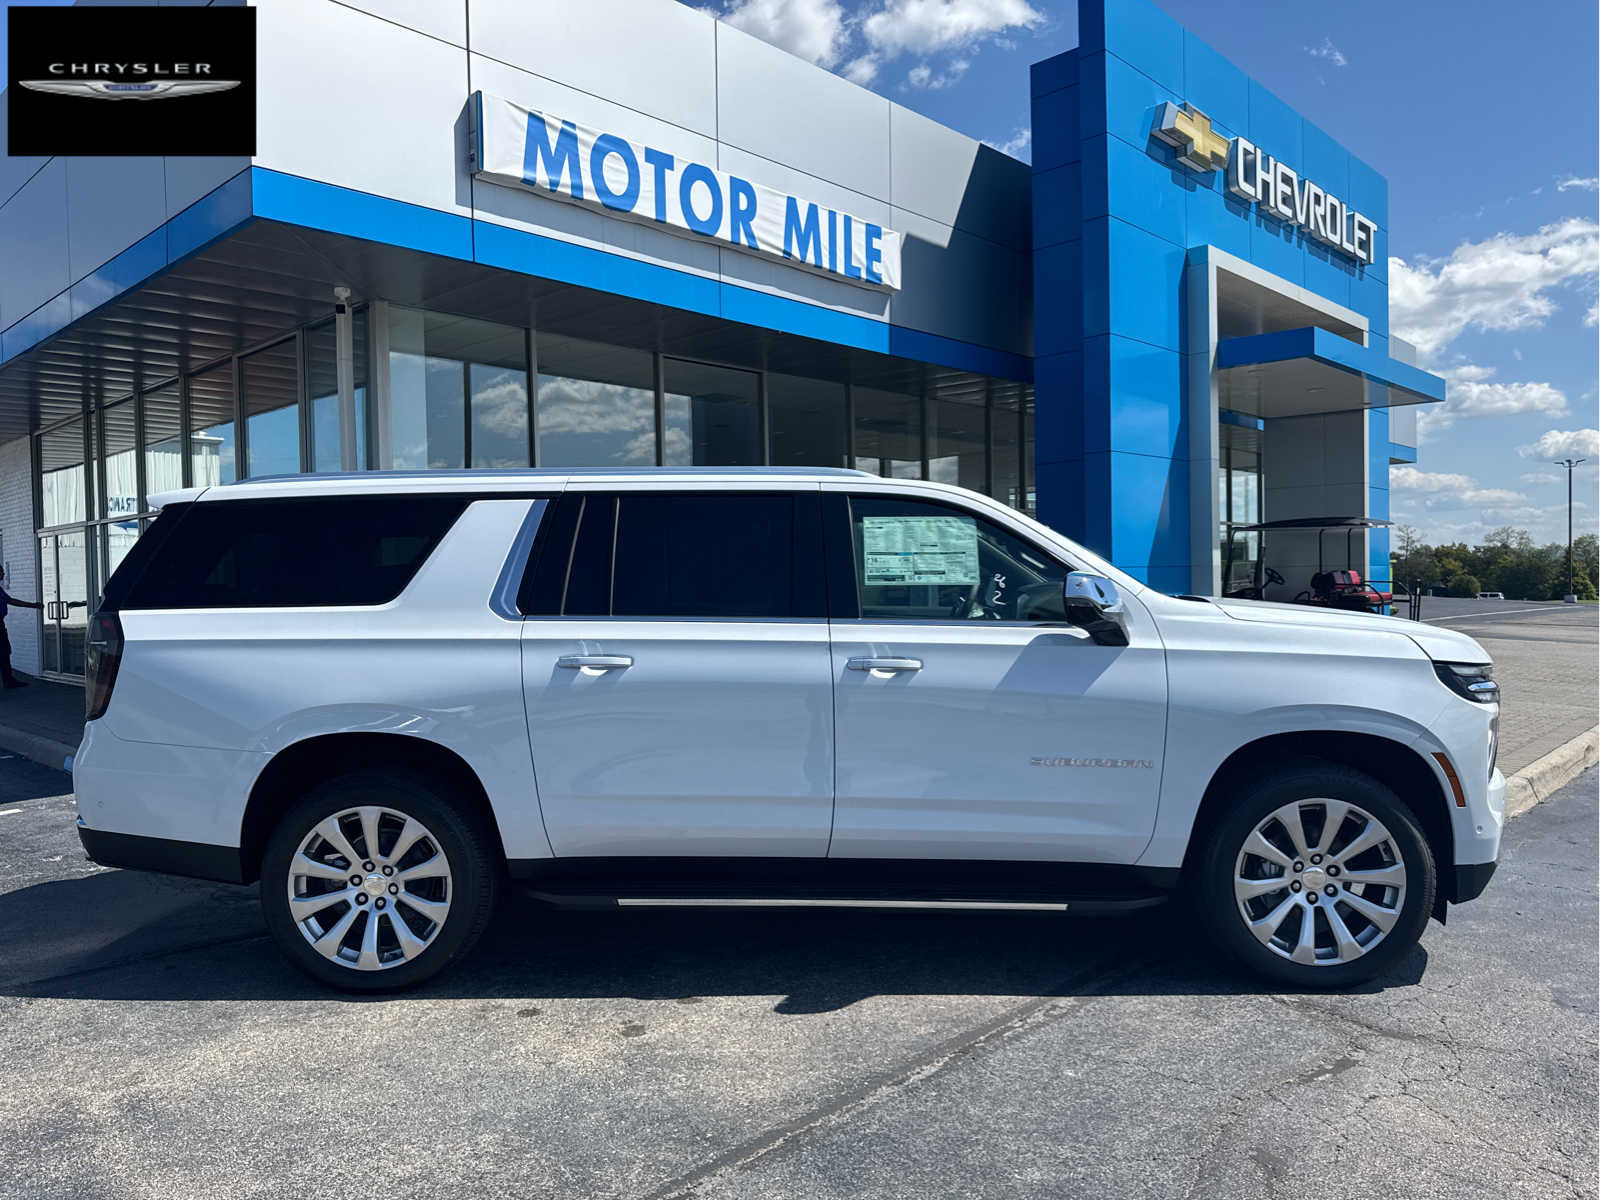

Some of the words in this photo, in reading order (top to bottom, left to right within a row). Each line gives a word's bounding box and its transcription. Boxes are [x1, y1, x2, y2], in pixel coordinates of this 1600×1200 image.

[521, 110, 760, 251] MOTOR
[782, 196, 883, 285] MILE
[1236, 136, 1378, 264] CHEVROLET
[1030, 757, 1153, 769] SUBURBAN
